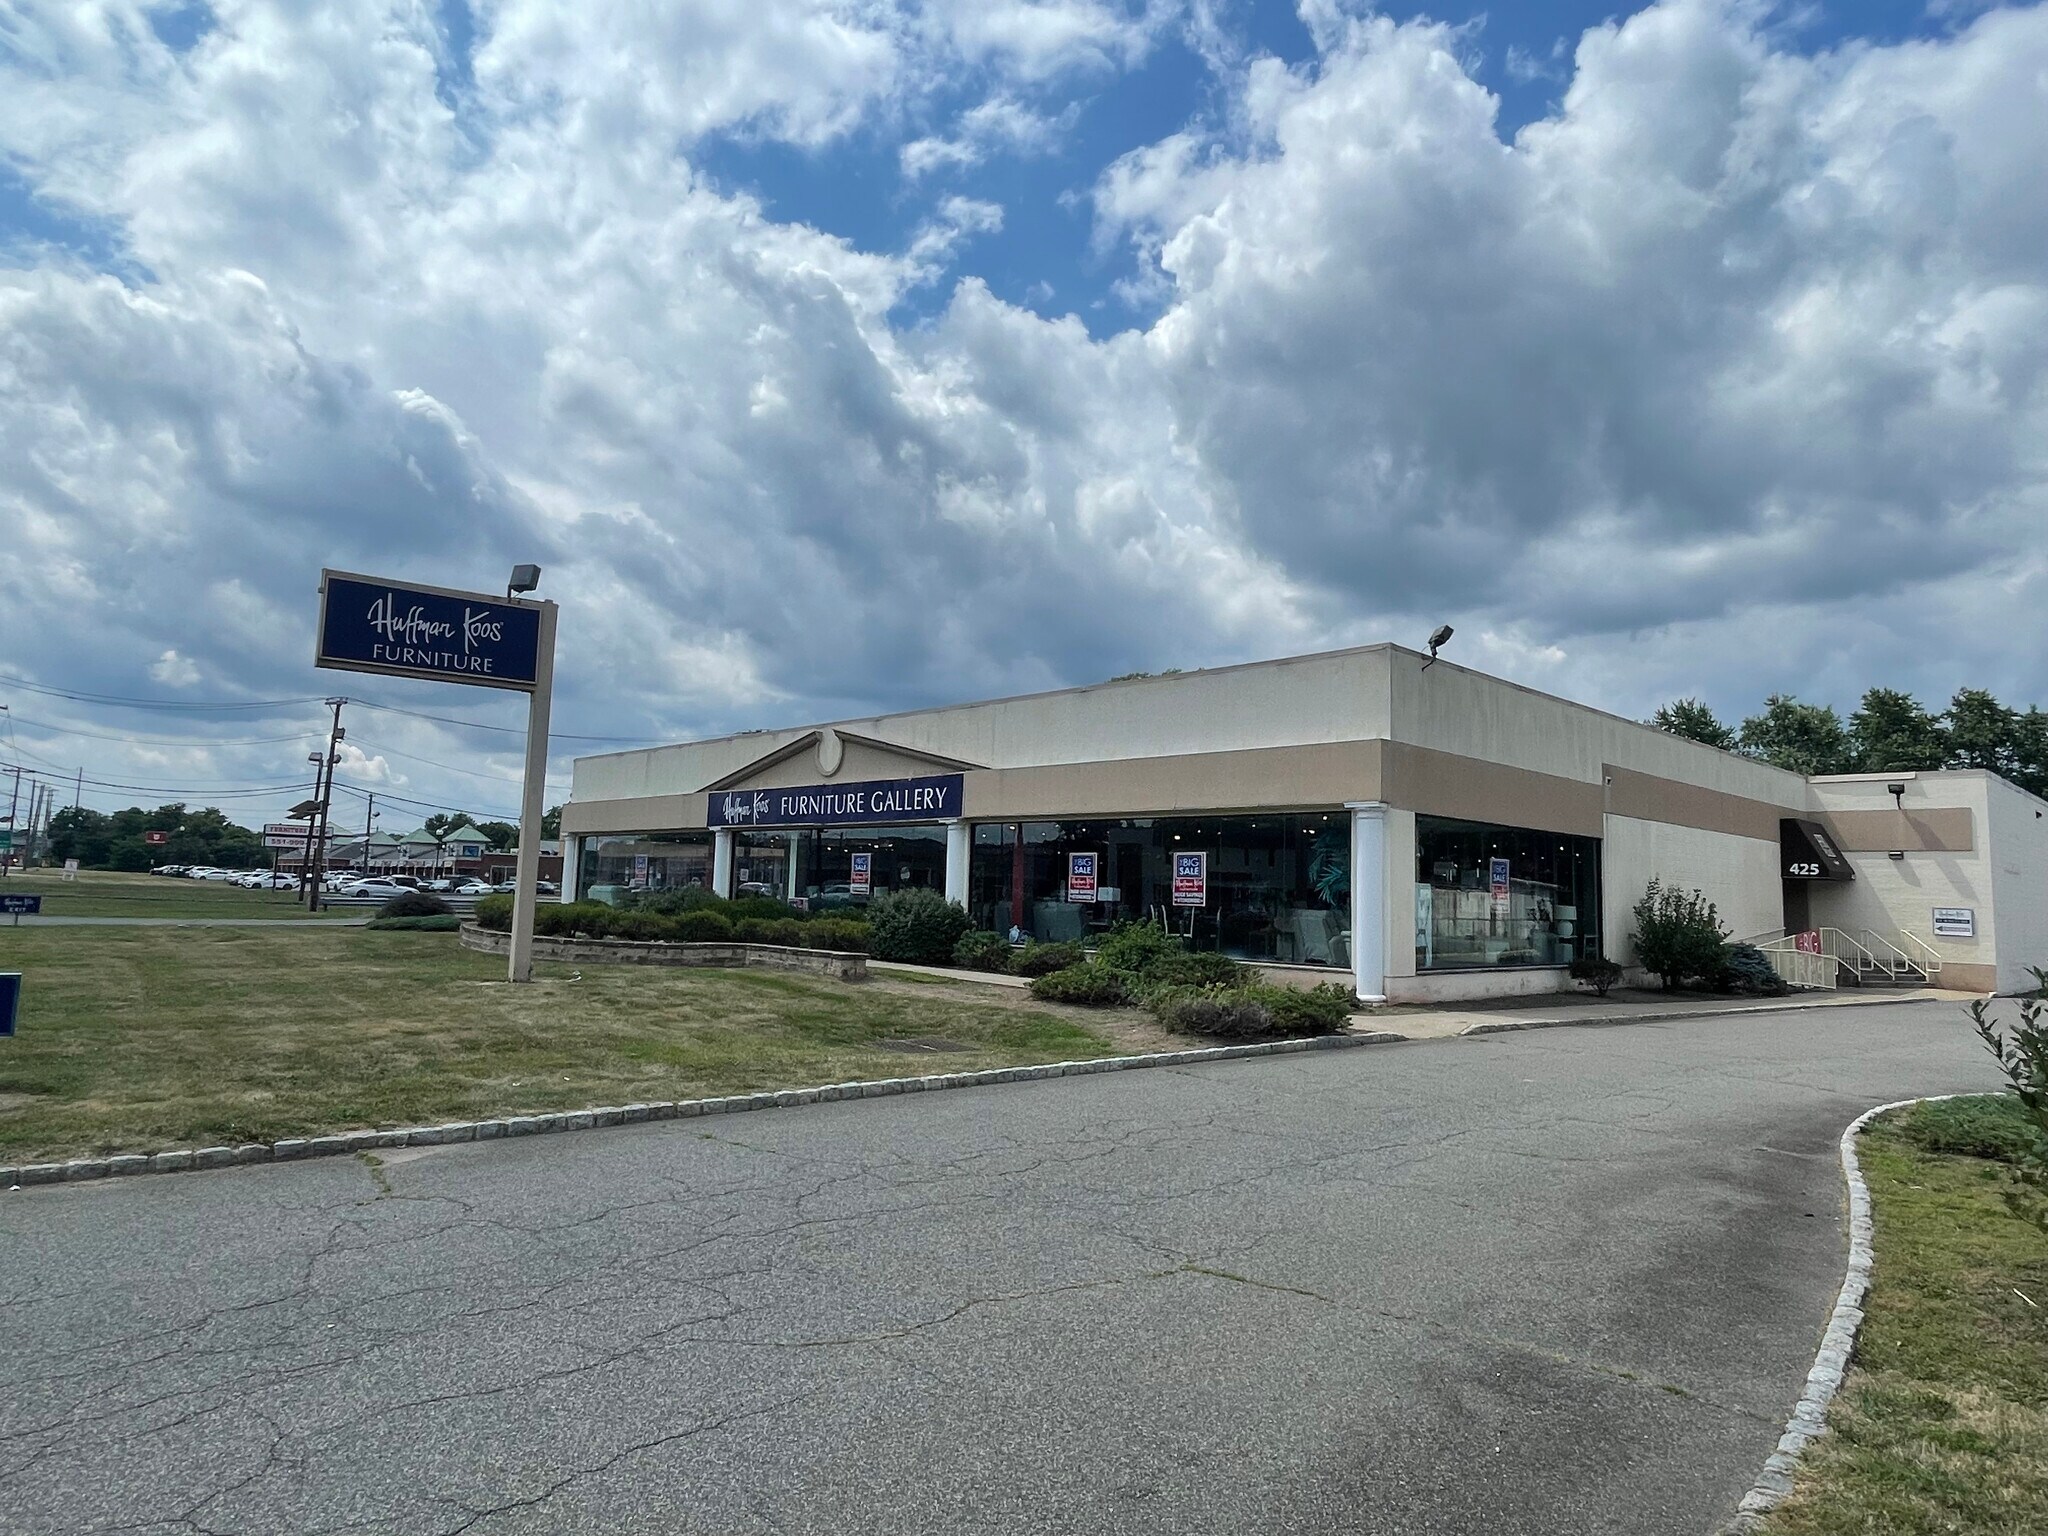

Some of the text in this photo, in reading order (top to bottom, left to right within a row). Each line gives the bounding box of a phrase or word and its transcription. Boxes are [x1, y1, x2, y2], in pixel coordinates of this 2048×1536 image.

[367, 593, 502, 654] Huffman Koos
[373, 644, 493, 673] FURNITURE
[781, 792, 865, 816] FURNITURE
[870, 787, 947, 812] GALLERY
[1074, 866, 1092, 874] SALE
[1179, 867, 1199, 875] SALE
[1789, 863, 1820, 875] 425
[1493, 874, 1506, 882] SALE
